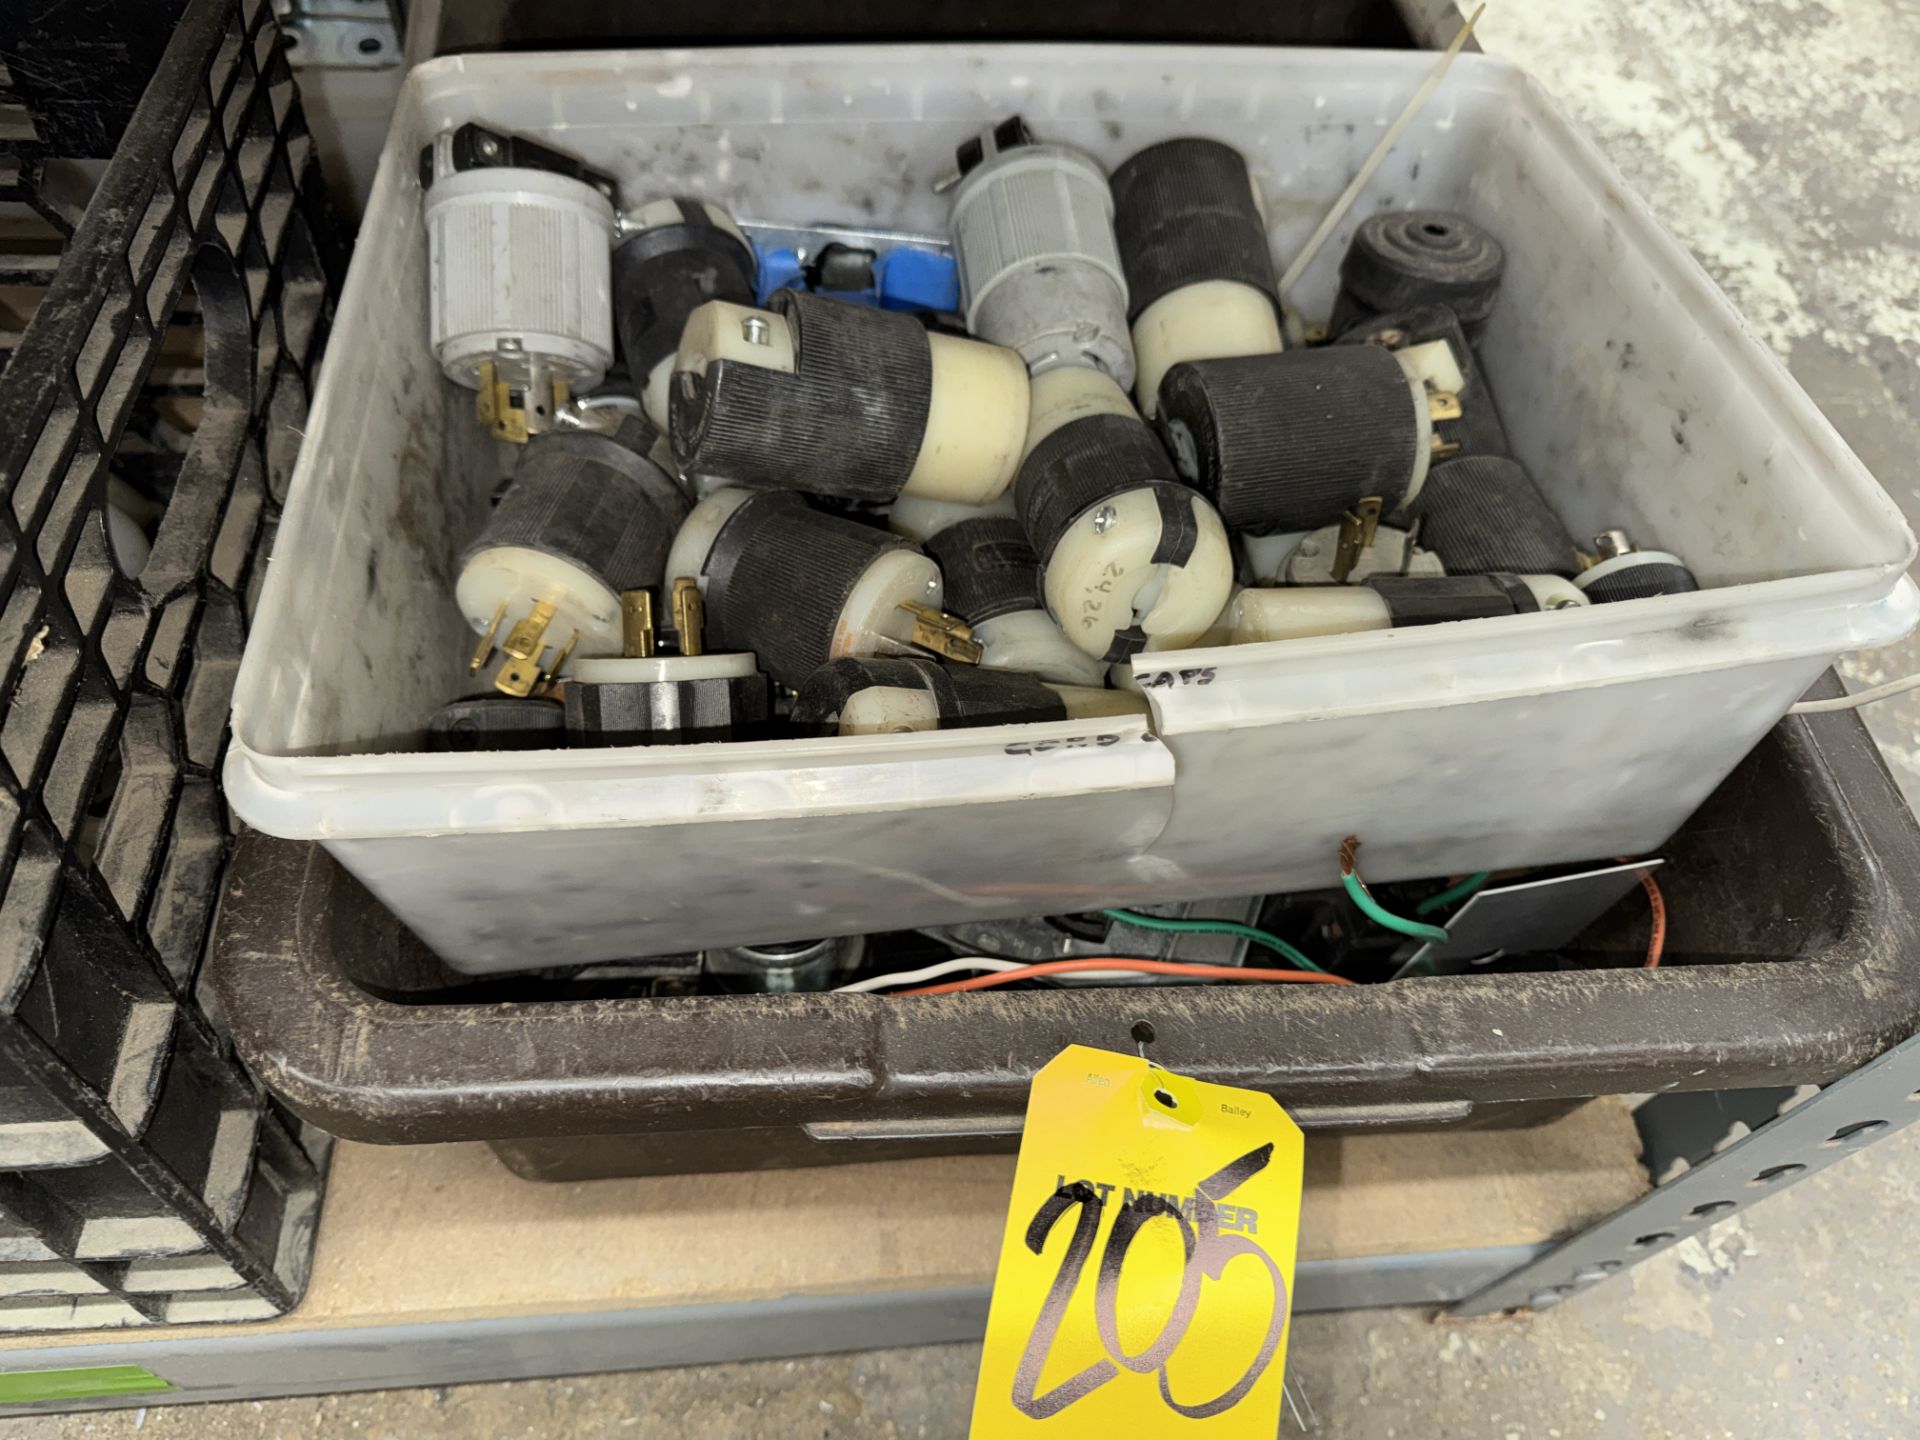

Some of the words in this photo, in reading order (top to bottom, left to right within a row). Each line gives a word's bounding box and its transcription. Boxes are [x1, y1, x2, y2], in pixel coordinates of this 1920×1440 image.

[1135, 667, 1218, 688] CAPS
[1221, 1103, 1252, 1118] Bailey
[1056, 1174, 1115, 1208] LOT
[1121, 1186, 1259, 1234] NUMER
[1011, 1142, 1288, 1419] 205
